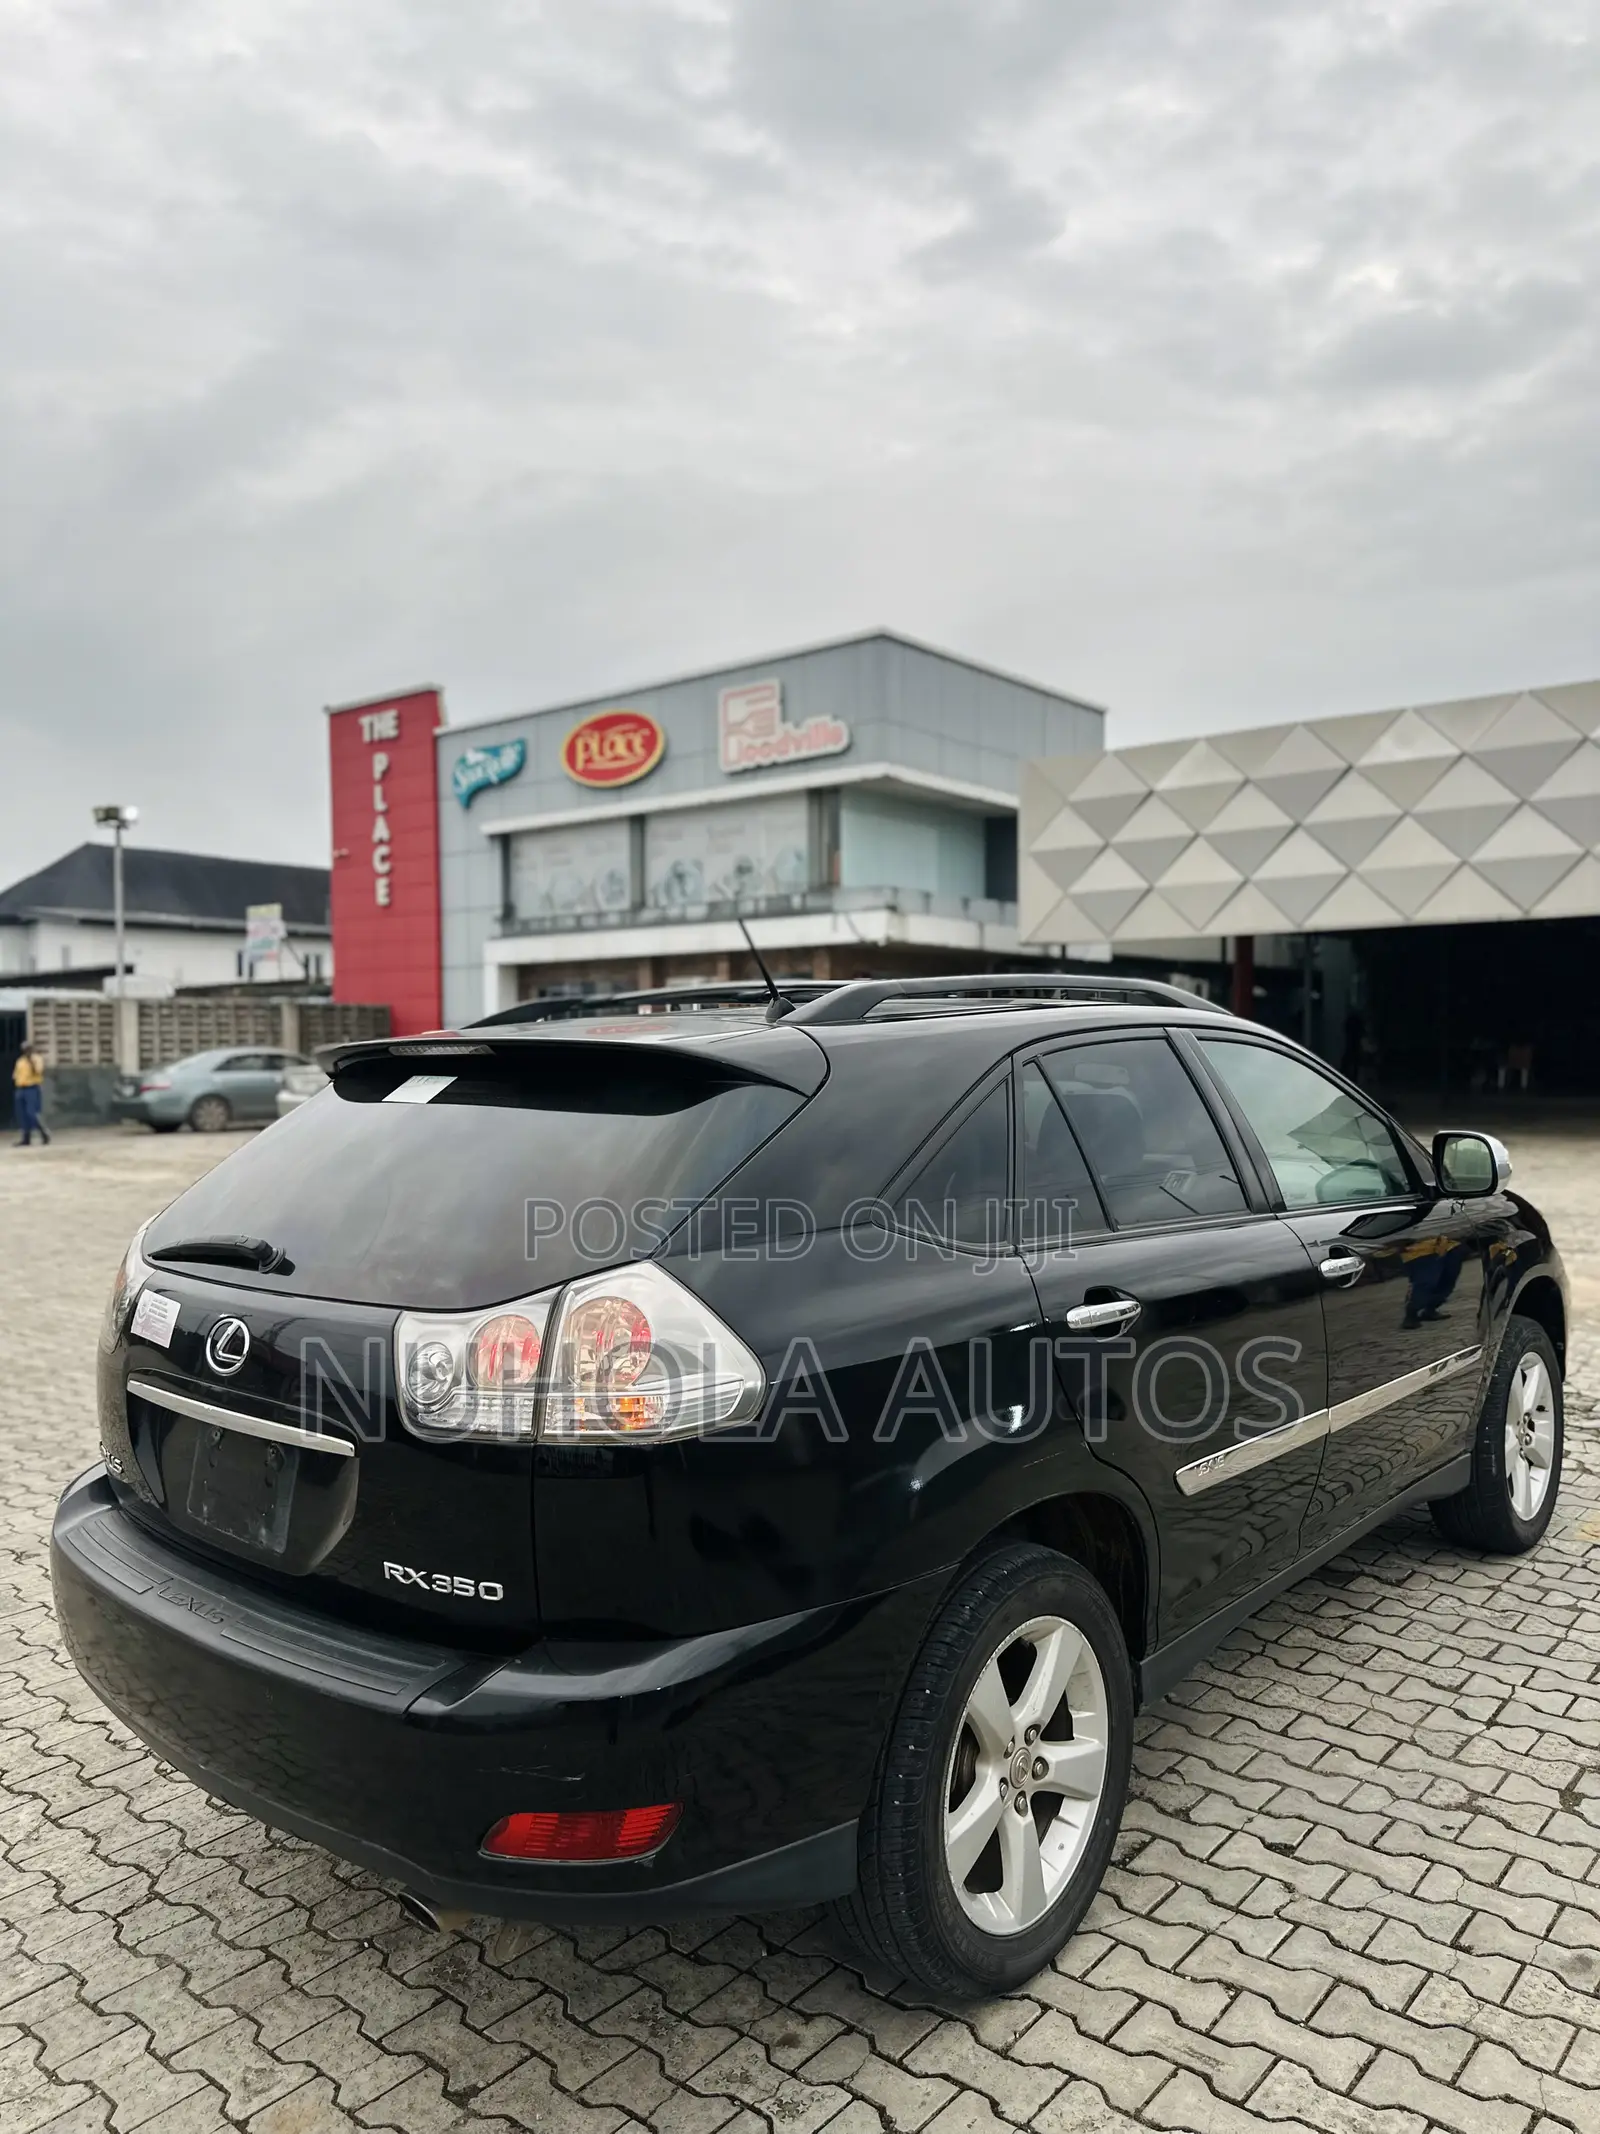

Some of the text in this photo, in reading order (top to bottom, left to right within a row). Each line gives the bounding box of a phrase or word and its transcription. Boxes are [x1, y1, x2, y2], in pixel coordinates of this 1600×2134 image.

[358, 709, 399, 743] THE
[372, 752, 391, 907] PLACE
[383, 1561, 504, 1601] RX350
[157, 1586, 230, 1625] LEXUS
